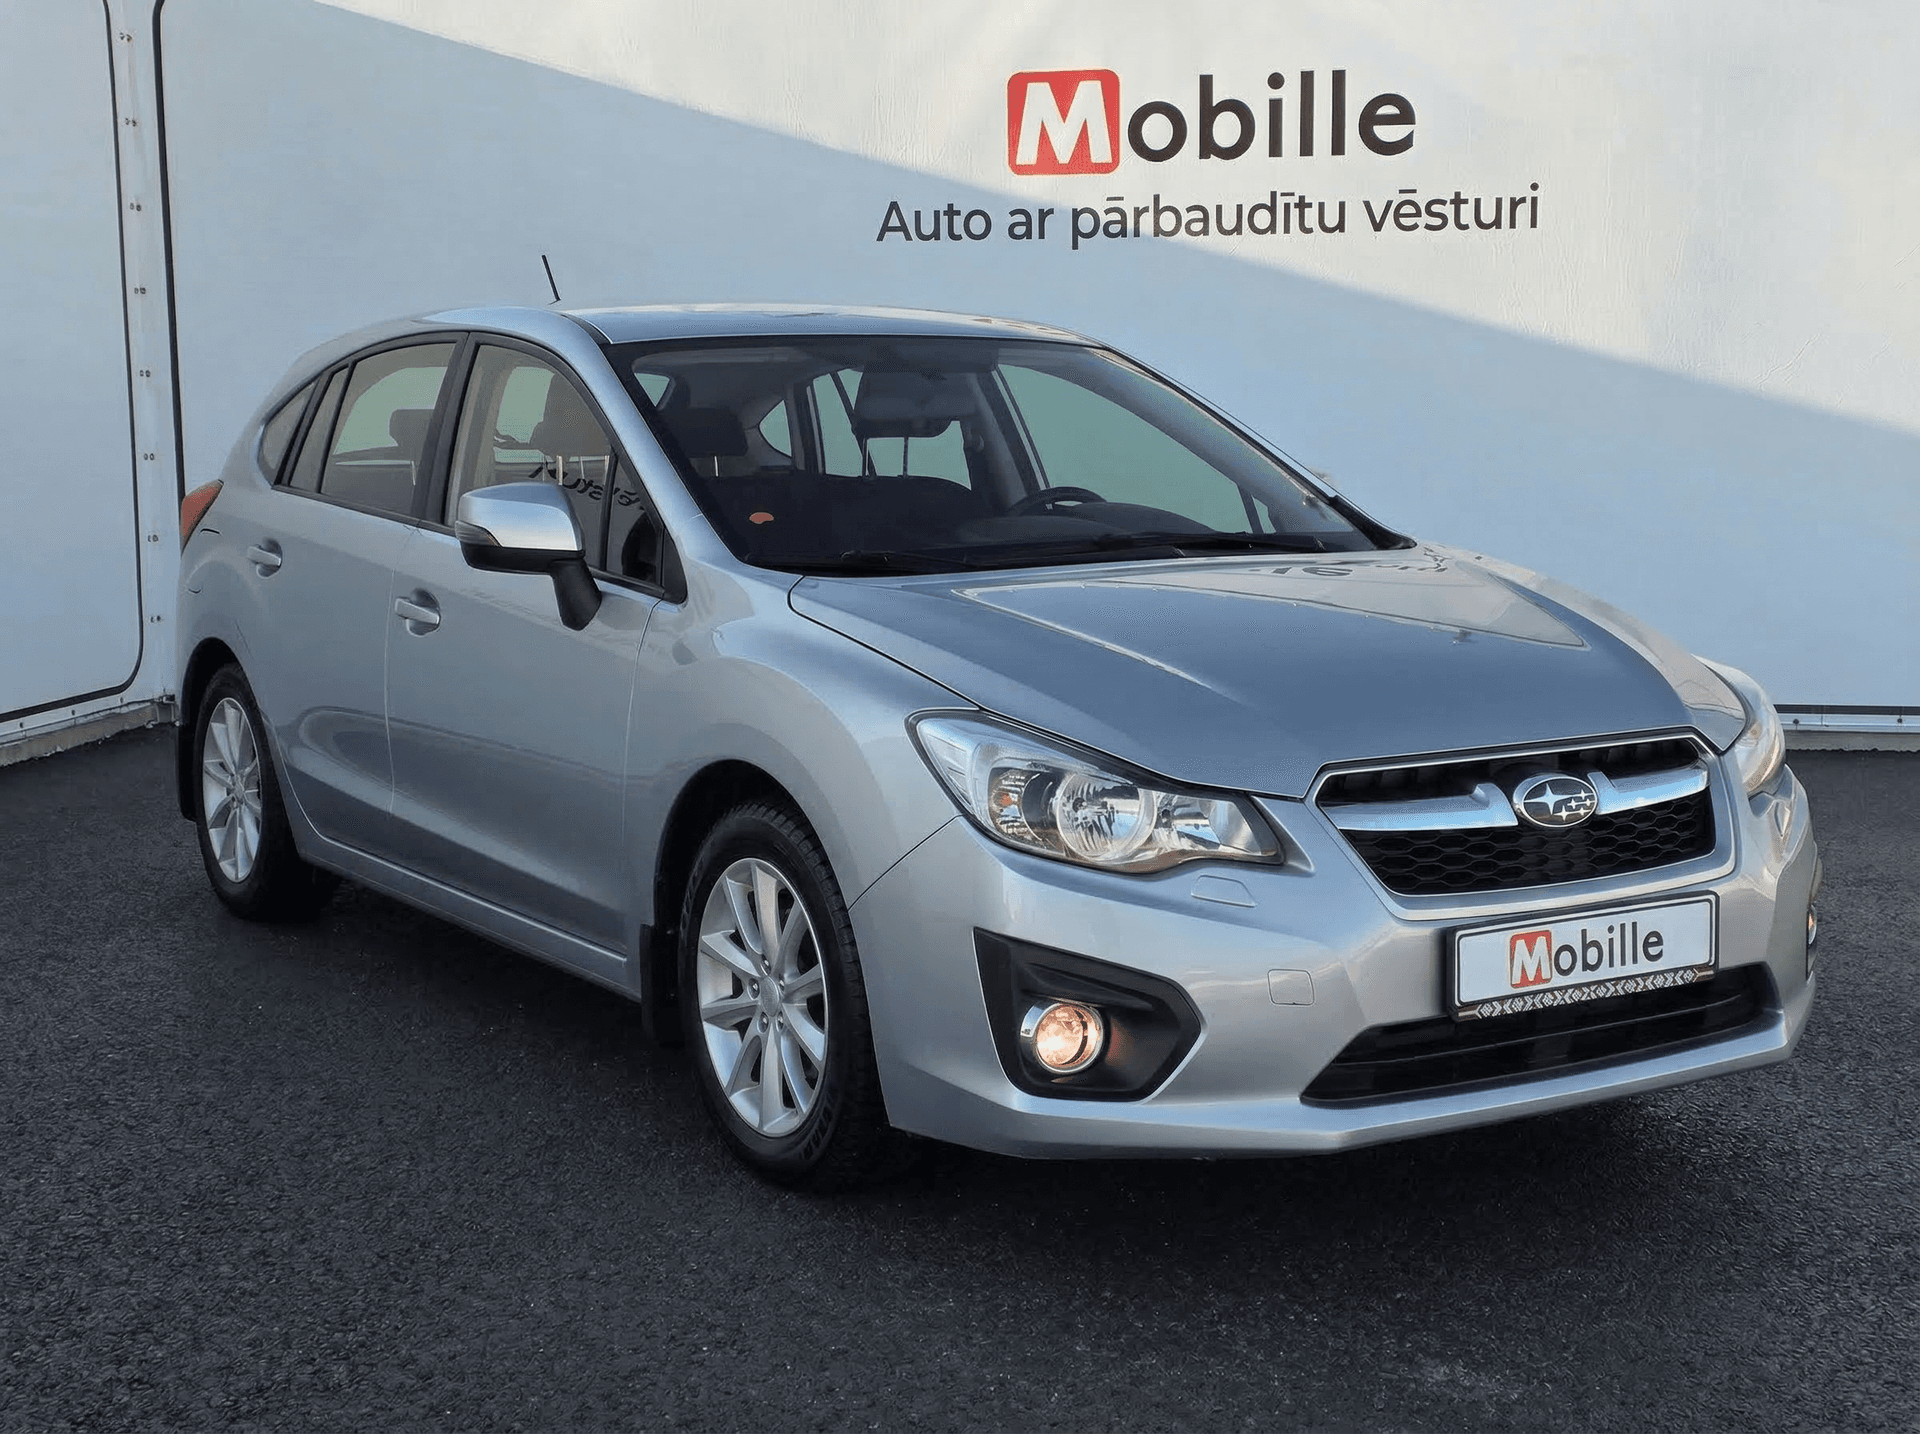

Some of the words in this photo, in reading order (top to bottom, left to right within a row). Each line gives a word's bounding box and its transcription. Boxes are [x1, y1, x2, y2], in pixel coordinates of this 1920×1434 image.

[1013, 69, 1417, 167] Mobille
[876, 200, 993, 242] Auto
[1007, 207, 1055, 240] ar
[1071, 191, 1347, 251] pārbaudītu
[1362, 182, 1539, 233] vēsturi
[1510, 920, 1665, 986] Mobille
